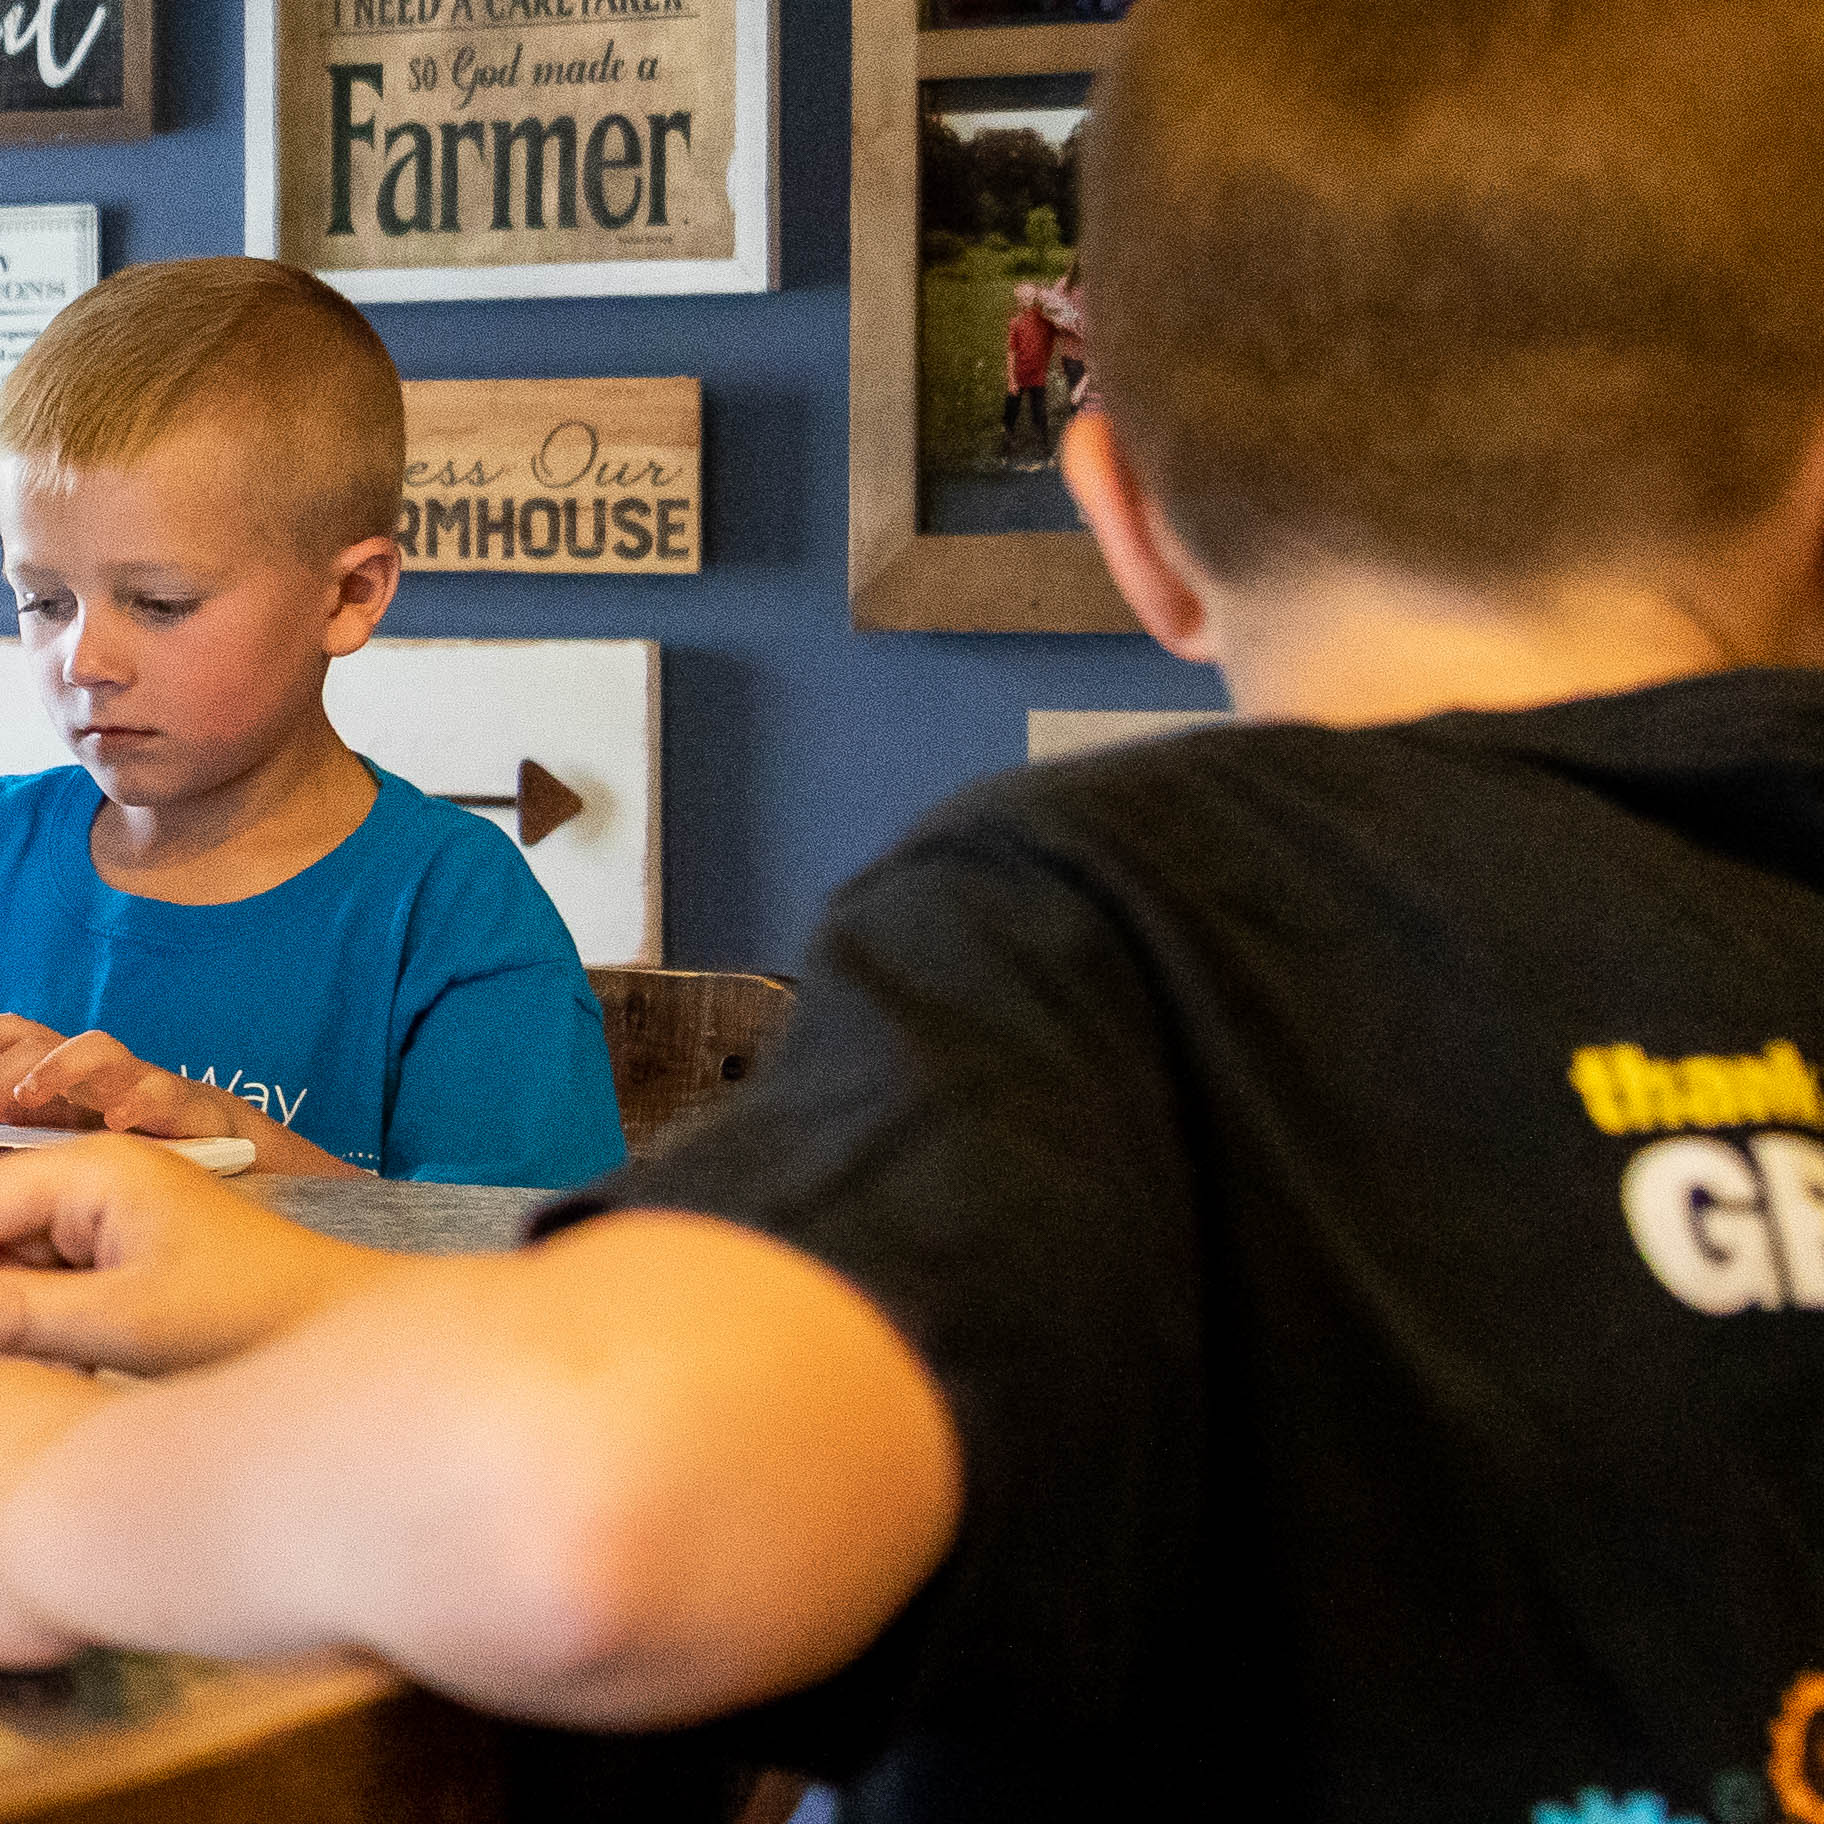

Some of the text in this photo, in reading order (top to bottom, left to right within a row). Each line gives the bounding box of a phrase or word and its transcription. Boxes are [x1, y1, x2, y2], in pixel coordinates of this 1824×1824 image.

[451, 42, 523, 110] God
[533, 39, 625, 88] made
[637, 55, 660, 81] a
[327, 62, 692, 236] Farmer
[402, 419, 683, 489] ess Our
[396, 496, 691, 561] RMHOUSE
